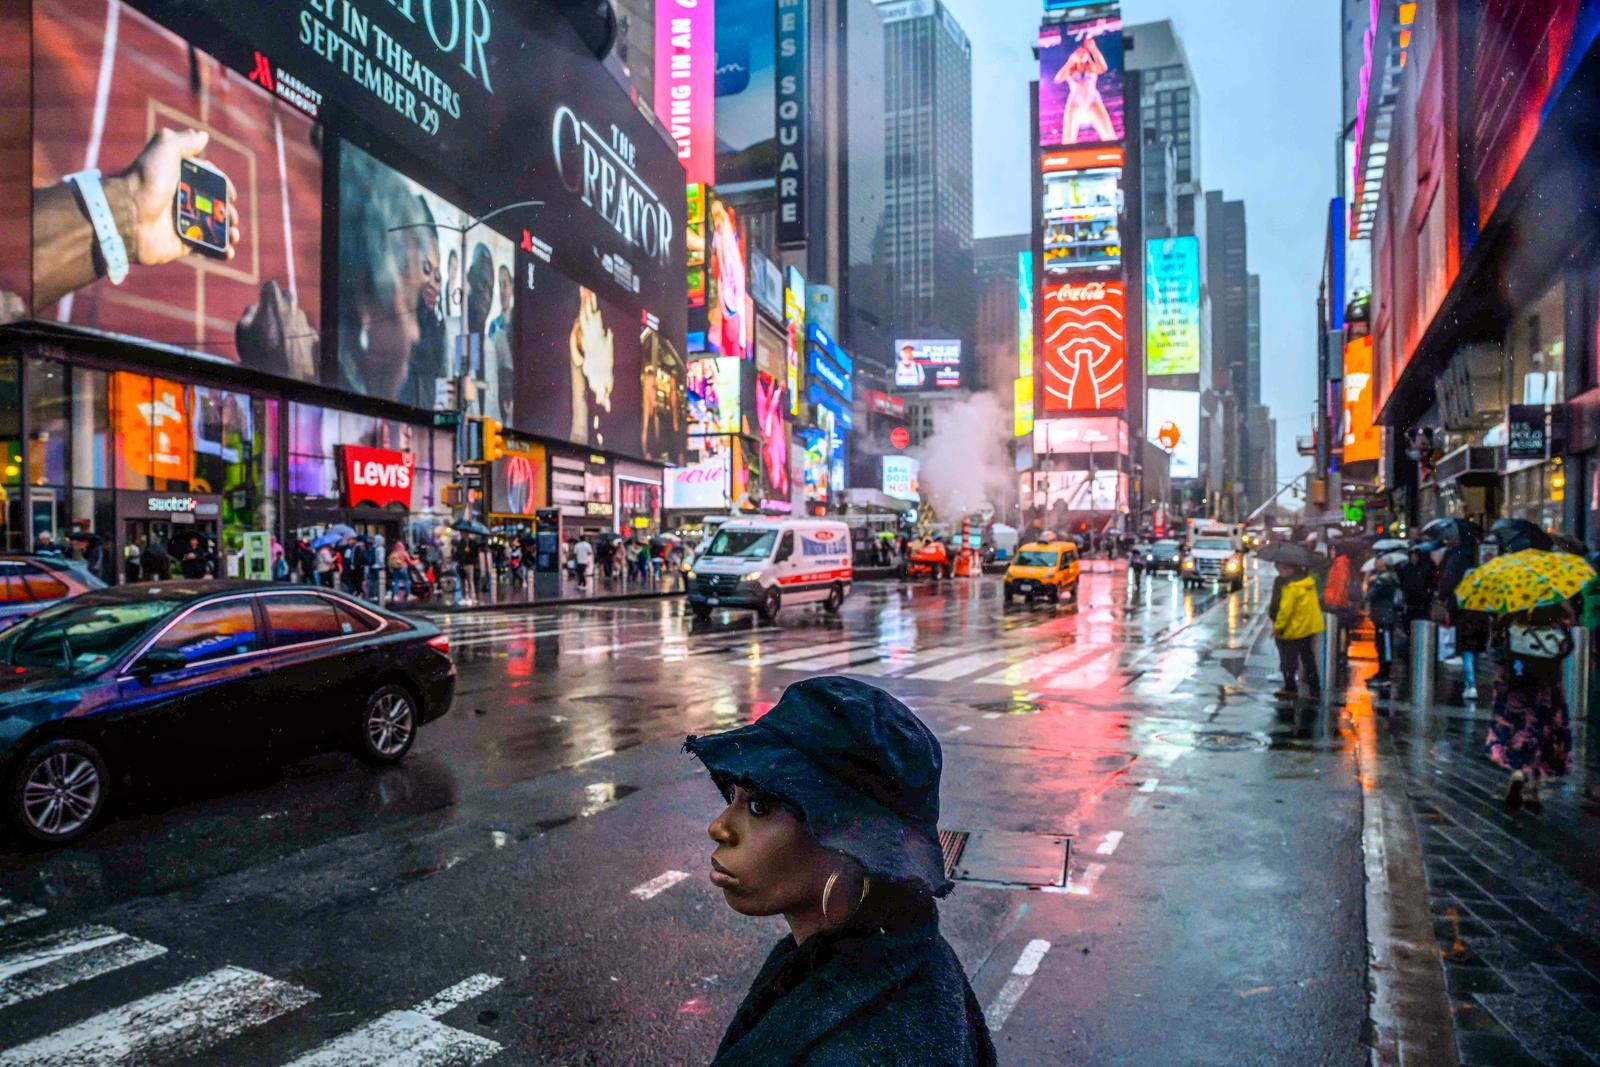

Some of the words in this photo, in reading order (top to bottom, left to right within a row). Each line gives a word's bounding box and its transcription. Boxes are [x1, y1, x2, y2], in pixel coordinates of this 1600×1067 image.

[342, 0, 368, 47] IN
[372, 24, 461, 120] THEATERS
[671, 18, 691, 49] AN
[276, 67, 322, 105] MARRIOTT
[300, 10, 418, 124] SEPTEMBER
[420, 101, 440, 136] 29
[671, 55, 691, 78] IN
[276, 82, 318, 116] MARQUIS
[671, 84, 691, 159] LIVING
[610, 123, 636, 169] THE
[780, 76, 799, 223] SQUARE
[552, 105, 673, 264] CREATOR
